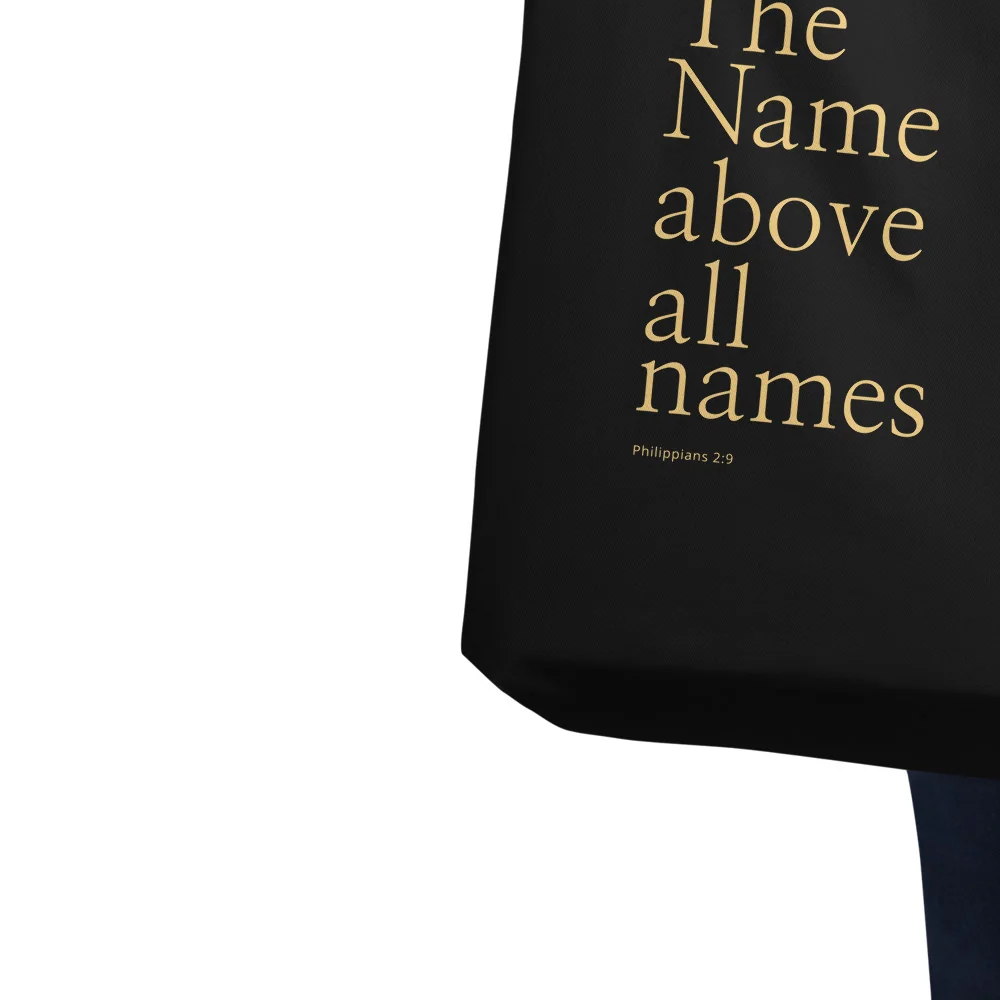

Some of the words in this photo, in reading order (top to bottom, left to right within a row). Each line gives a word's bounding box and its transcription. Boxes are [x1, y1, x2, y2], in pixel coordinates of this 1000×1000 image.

[662, 57, 940, 163] Name
[653, 157, 925, 262] above
[644, 259, 749, 349] all
[635, 359, 925, 438] names
[632, 444, 708, 462] Philippians
[712, 452, 734, 465] 2:9
